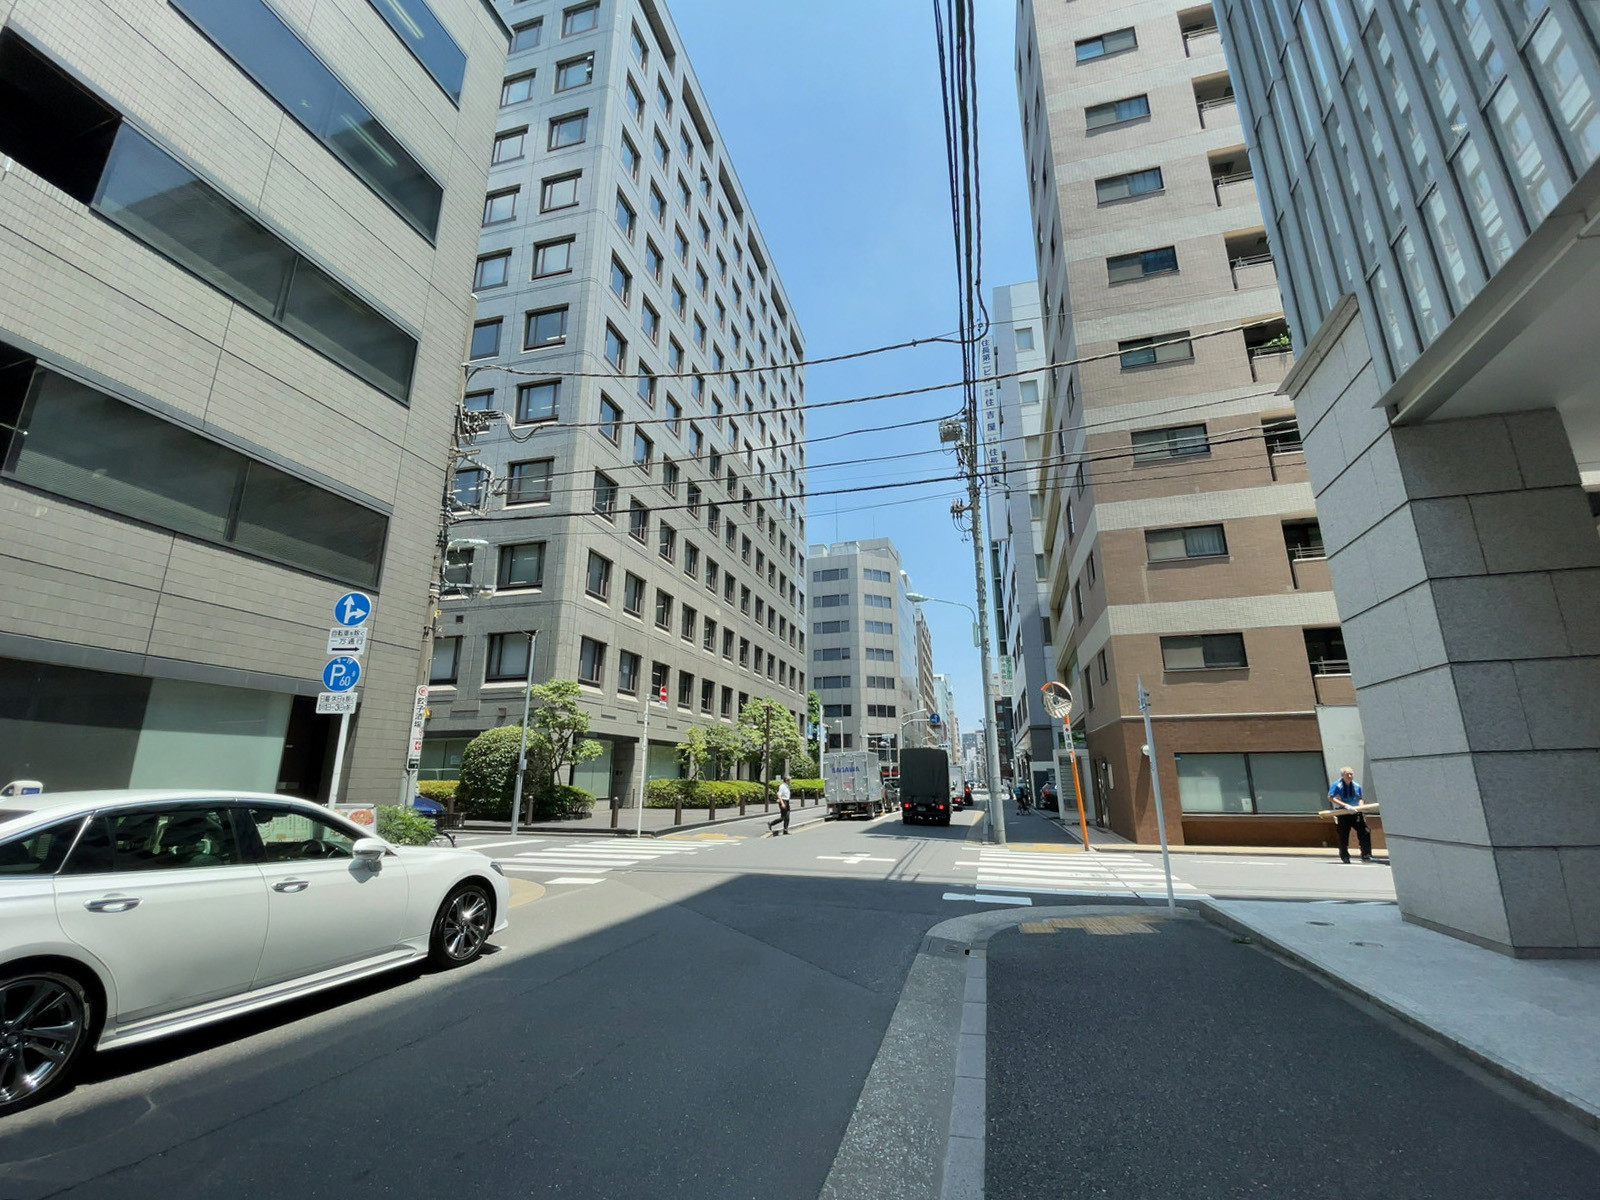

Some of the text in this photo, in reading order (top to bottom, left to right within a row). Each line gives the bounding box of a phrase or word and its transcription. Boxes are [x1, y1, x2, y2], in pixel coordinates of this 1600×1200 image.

[981, 339, 992, 382] 住長第二ビ
[985, 399, 996, 431] 住吉屋
[330, 637, 364, 645] 一方通行
[330, 664, 346, 687] P
[831, 766, 860, 774] SAGAWA
